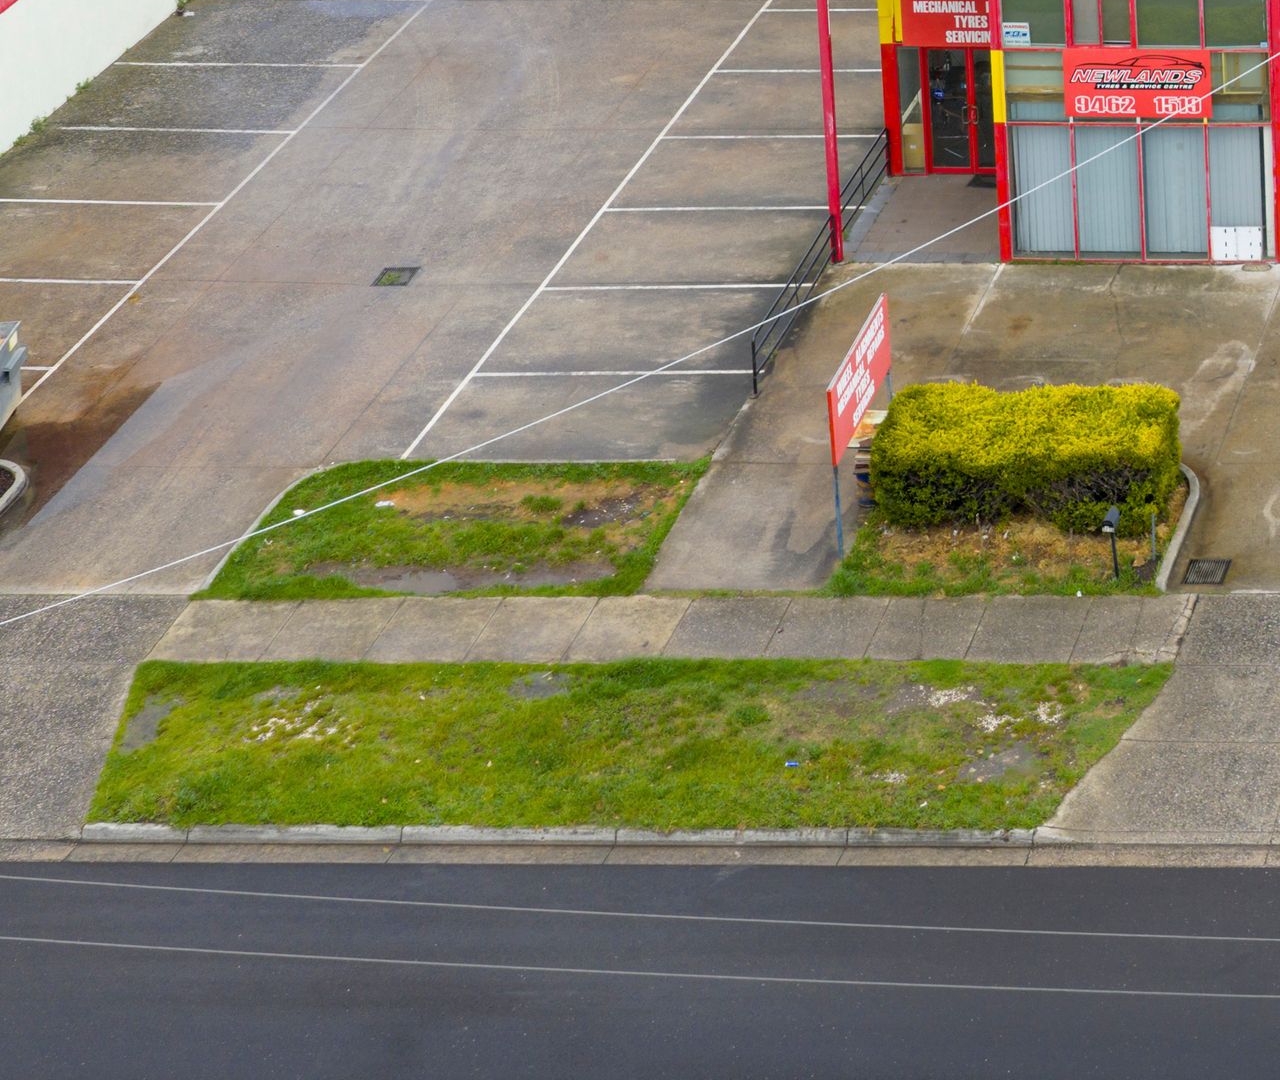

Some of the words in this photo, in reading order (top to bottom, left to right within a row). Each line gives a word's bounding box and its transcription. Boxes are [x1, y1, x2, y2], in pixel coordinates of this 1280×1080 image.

[913, 1, 977, 14] MECHANICAL
[954, 15, 988, 29] TYRES
[1070, 68, 1203, 84] NEWLANDS
[1075, 95, 1136, 114] 9462
